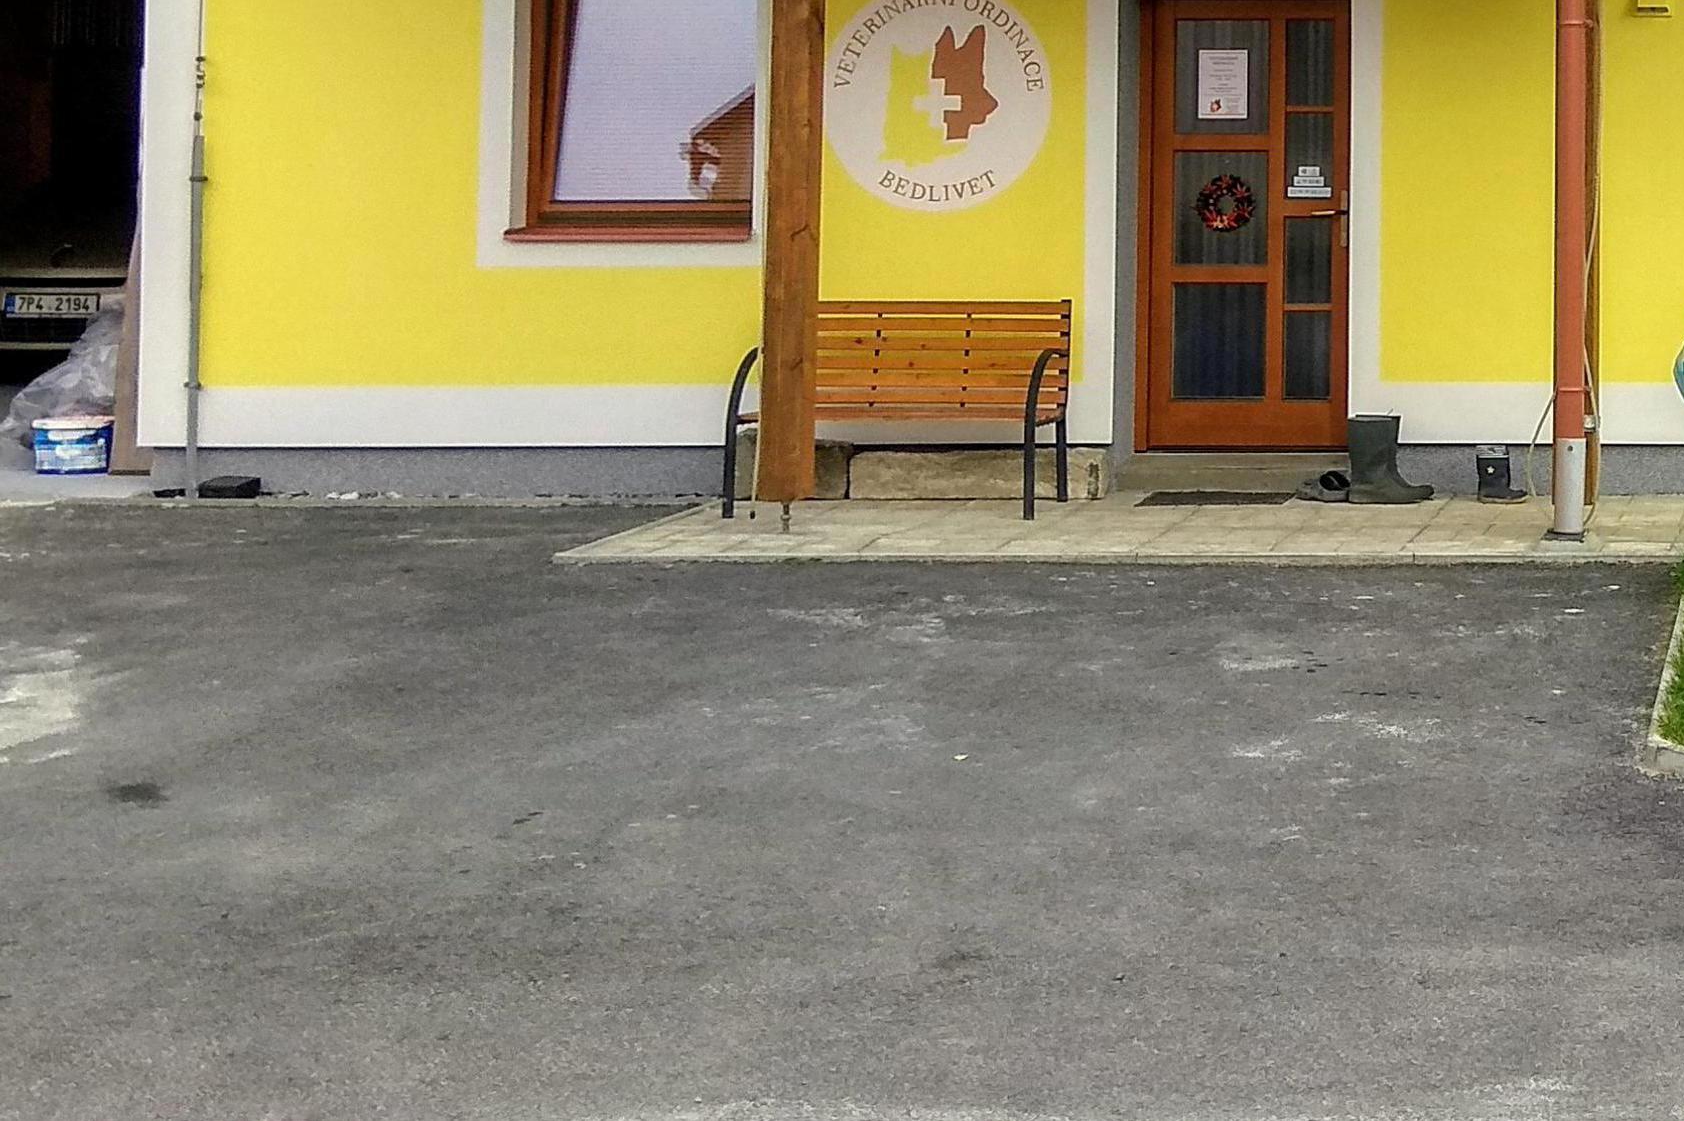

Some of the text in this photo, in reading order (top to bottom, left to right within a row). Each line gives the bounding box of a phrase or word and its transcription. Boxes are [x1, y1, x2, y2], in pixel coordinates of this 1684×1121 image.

[878, 169, 998, 202] BEDLIVET
[18, 296, 90, 312] 7P4 2194
